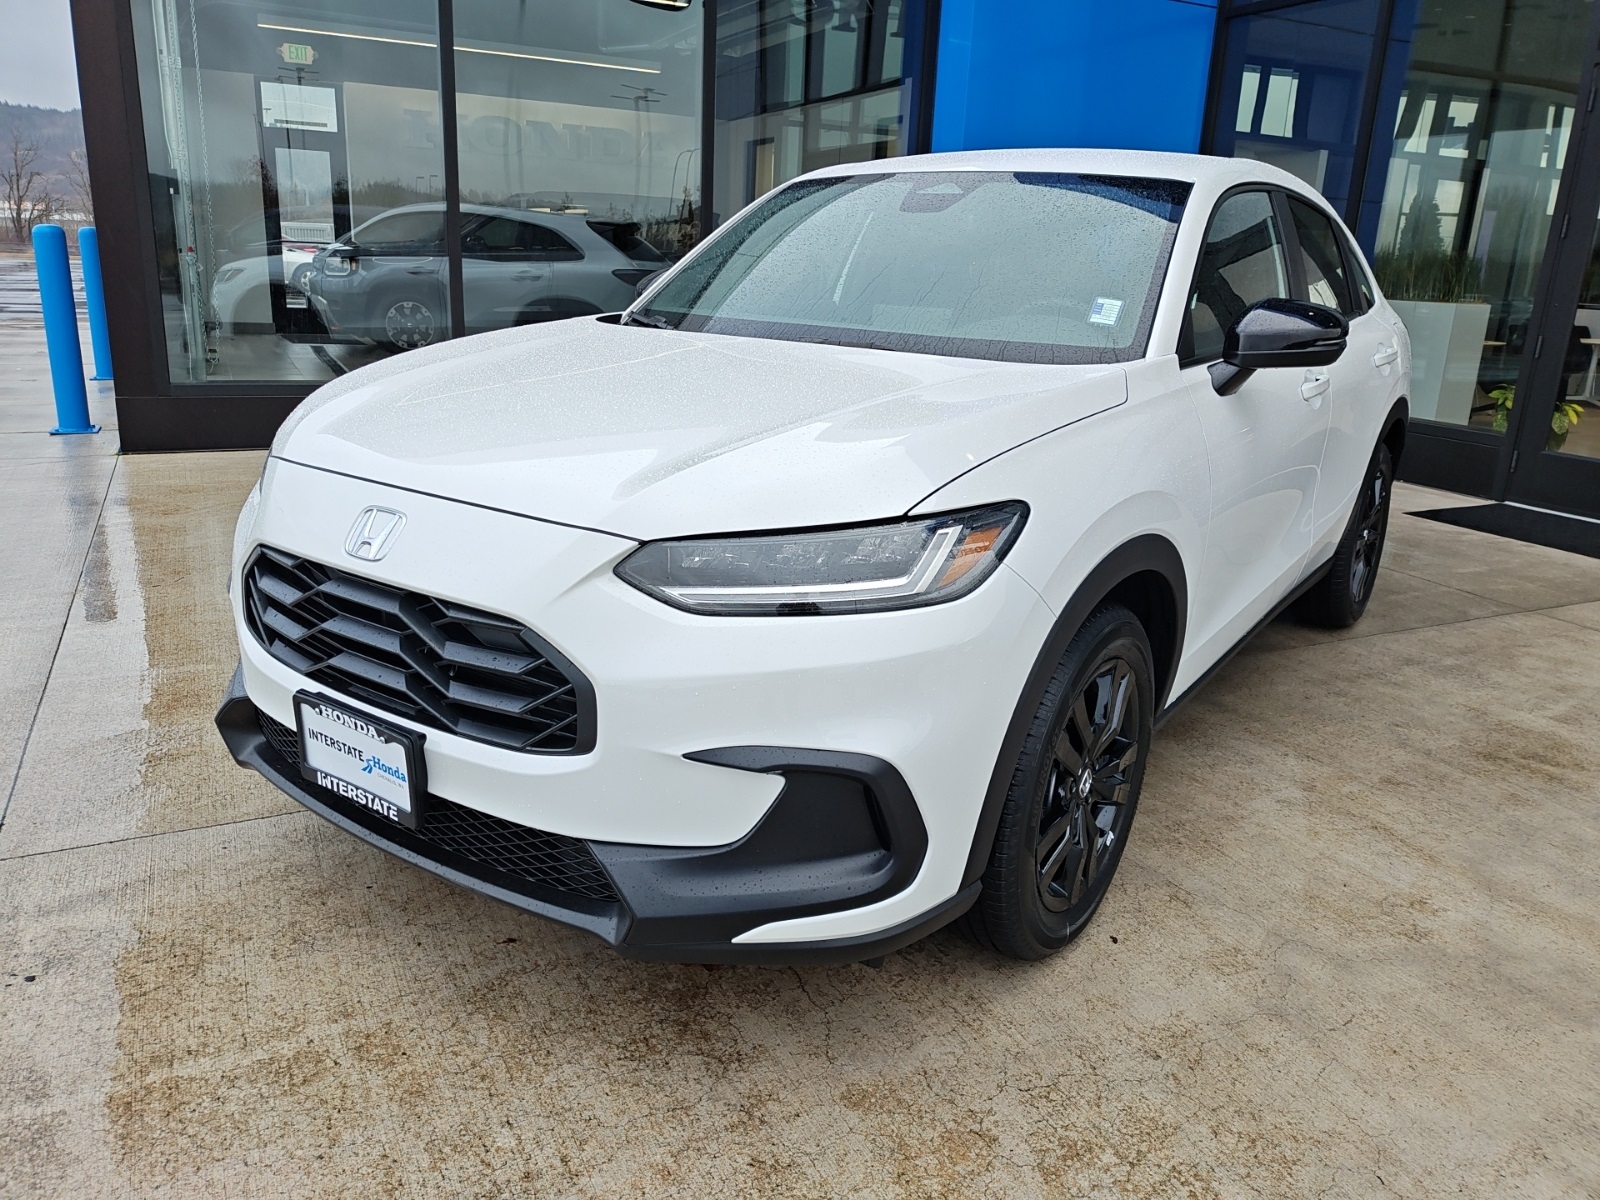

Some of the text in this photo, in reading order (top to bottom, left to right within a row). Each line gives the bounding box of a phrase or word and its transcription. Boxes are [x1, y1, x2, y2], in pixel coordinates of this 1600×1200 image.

[288, 44, 308, 62] EXIT
[319, 704, 381, 742] HONDA
[308, 727, 365, 763] INTERSTATE
[371, 755, 407, 783] Honda
[316, 771, 399, 822] INTERSTATE
